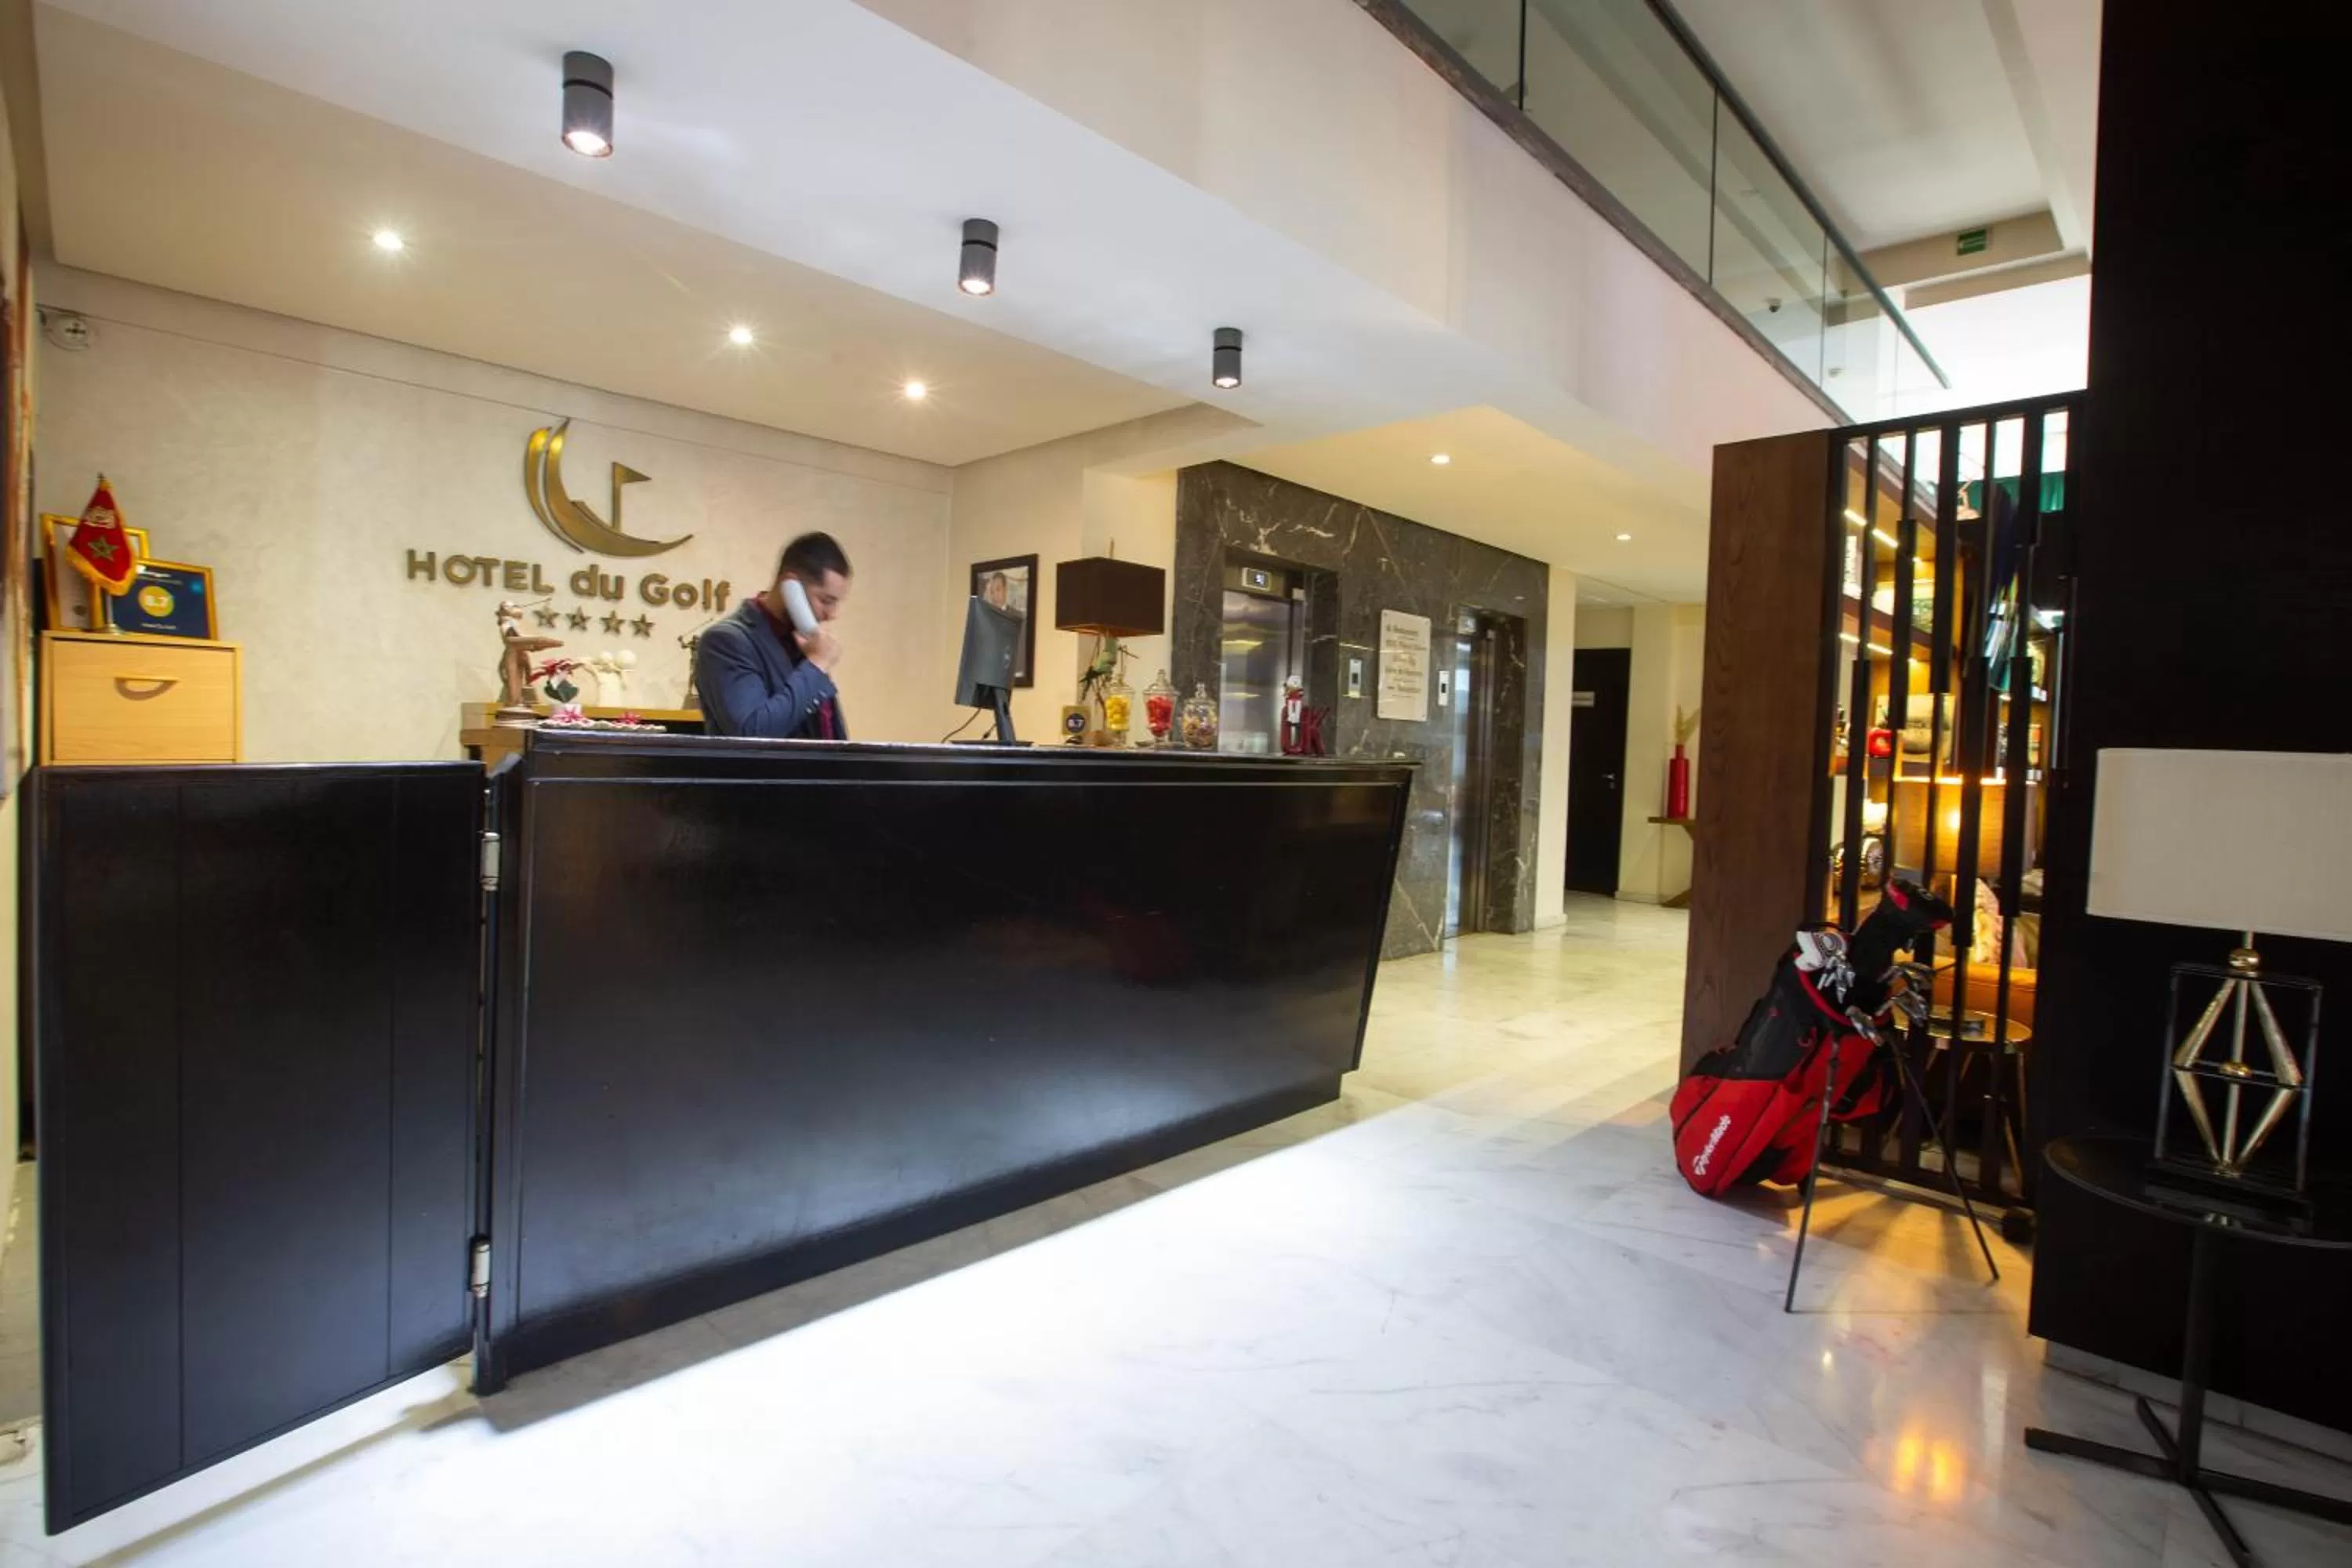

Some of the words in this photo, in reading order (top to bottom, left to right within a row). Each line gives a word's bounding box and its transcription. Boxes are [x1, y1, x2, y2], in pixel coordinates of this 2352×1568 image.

[407, 549, 555, 593] HOTEL
[570, 564, 625, 601] du
[640, 573, 731, 612] Golf
